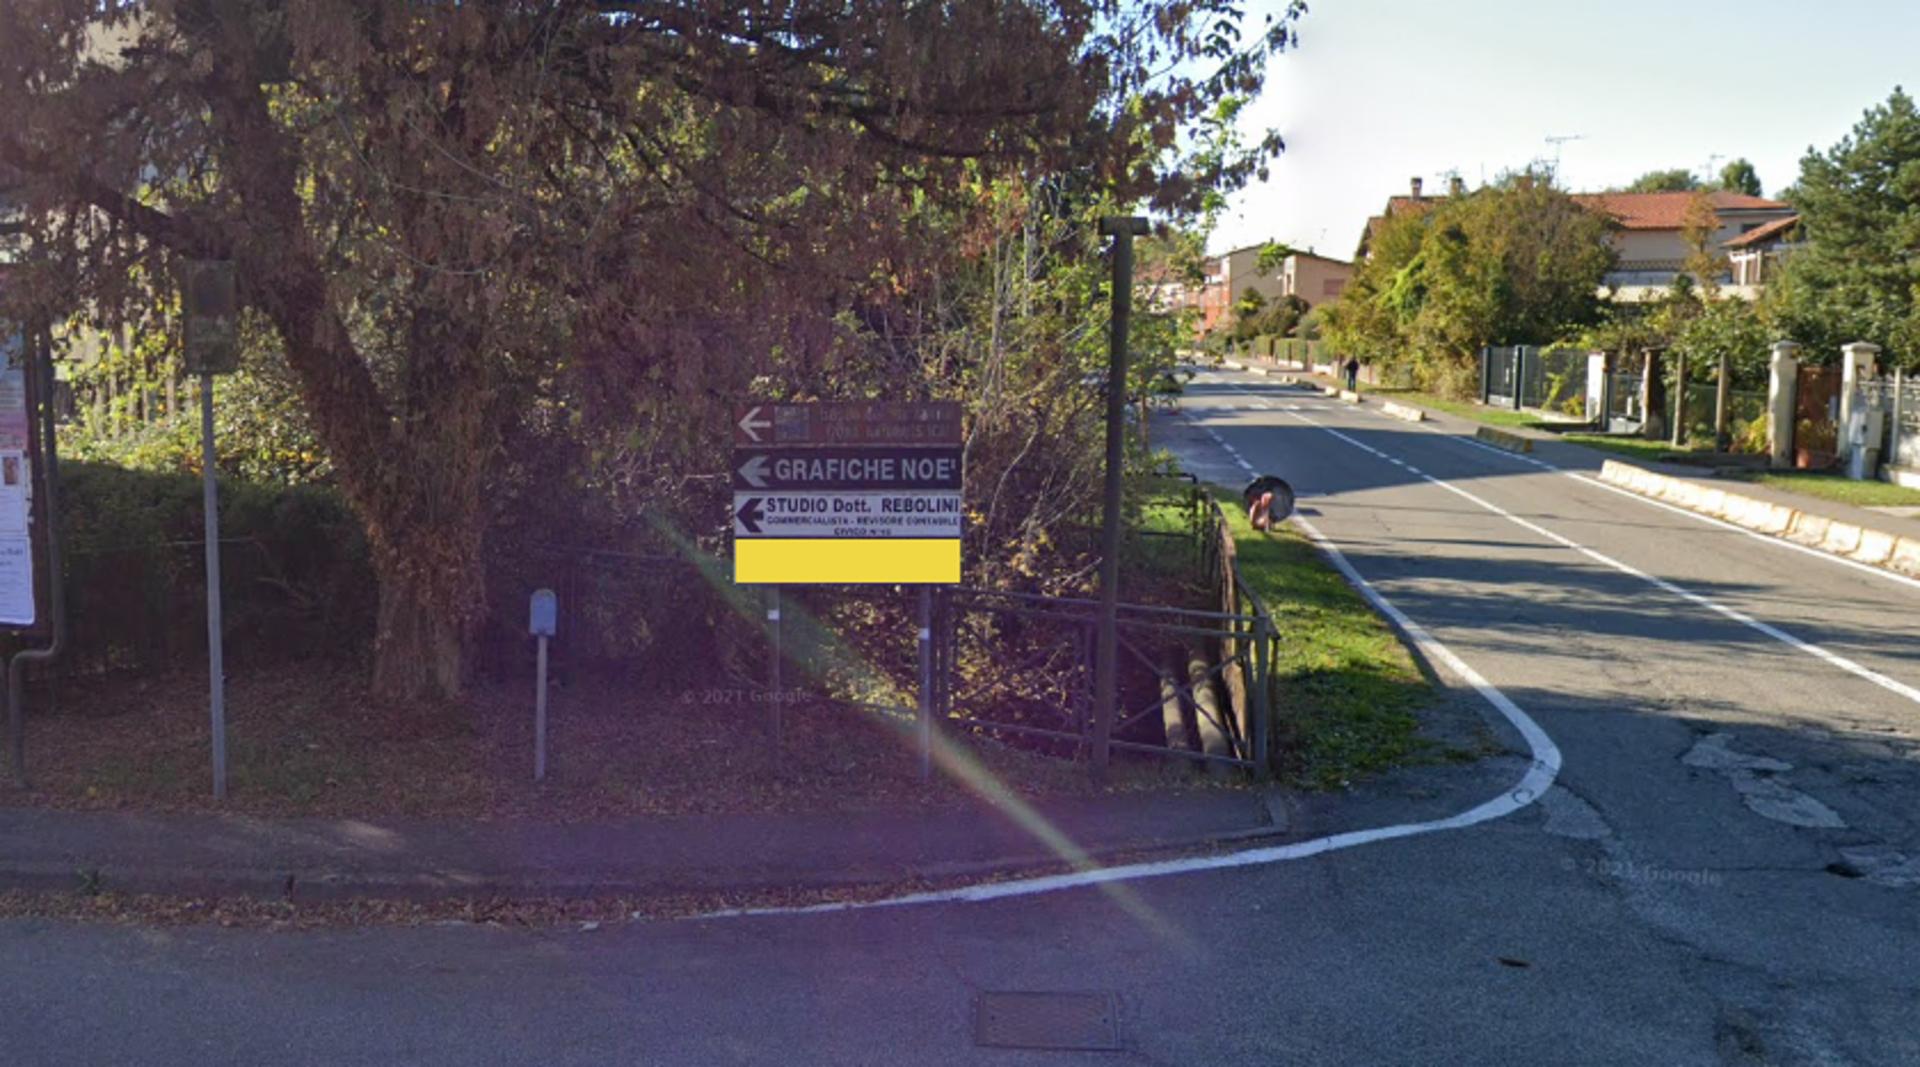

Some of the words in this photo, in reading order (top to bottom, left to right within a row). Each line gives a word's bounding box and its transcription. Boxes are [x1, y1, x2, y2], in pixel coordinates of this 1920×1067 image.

[775, 458, 894, 481] GRAFICHE
[902, 458, 957, 481] NOE'
[767, 497, 828, 513] STUDIO
[833, 497, 872, 513] Dott.
[881, 497, 959, 513] REBOLINI
[857, 516, 903, 526] REVISORE
